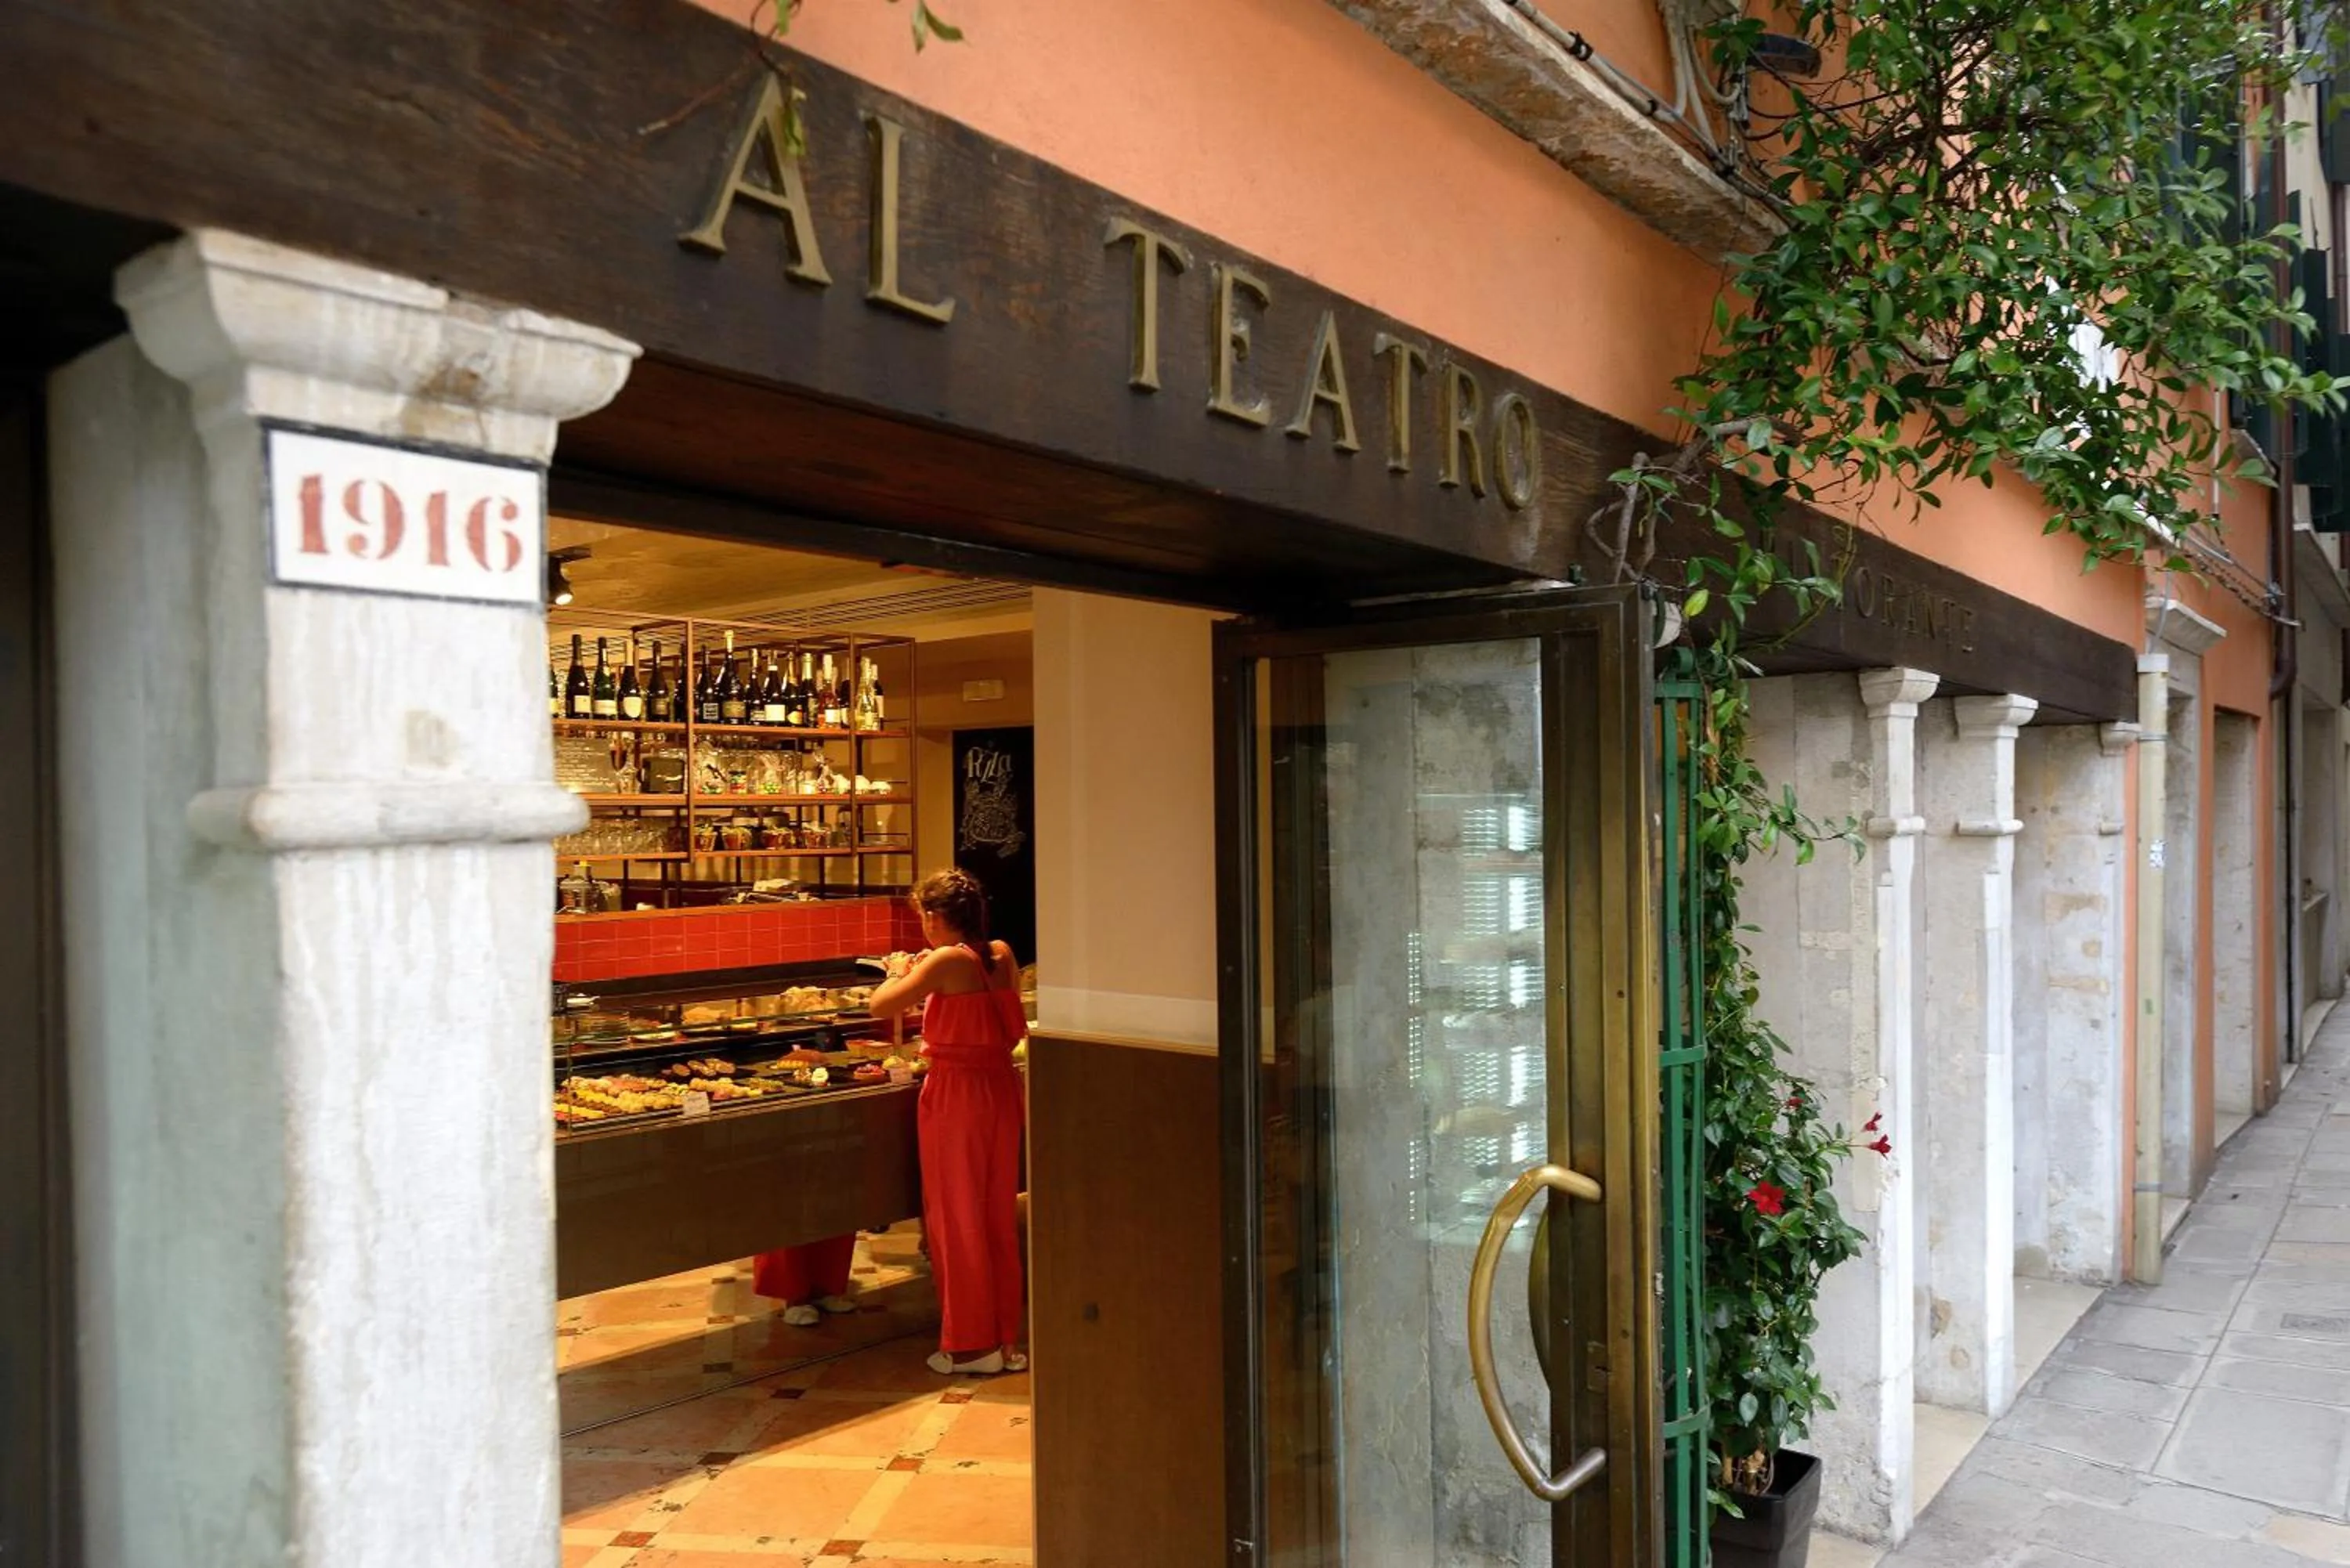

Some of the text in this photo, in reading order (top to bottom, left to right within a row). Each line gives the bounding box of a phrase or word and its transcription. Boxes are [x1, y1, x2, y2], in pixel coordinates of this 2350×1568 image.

[677, 70, 956, 324] AL
[1104, 215, 1541, 511] TEATRO
[297, 473, 523, 573] 1916
